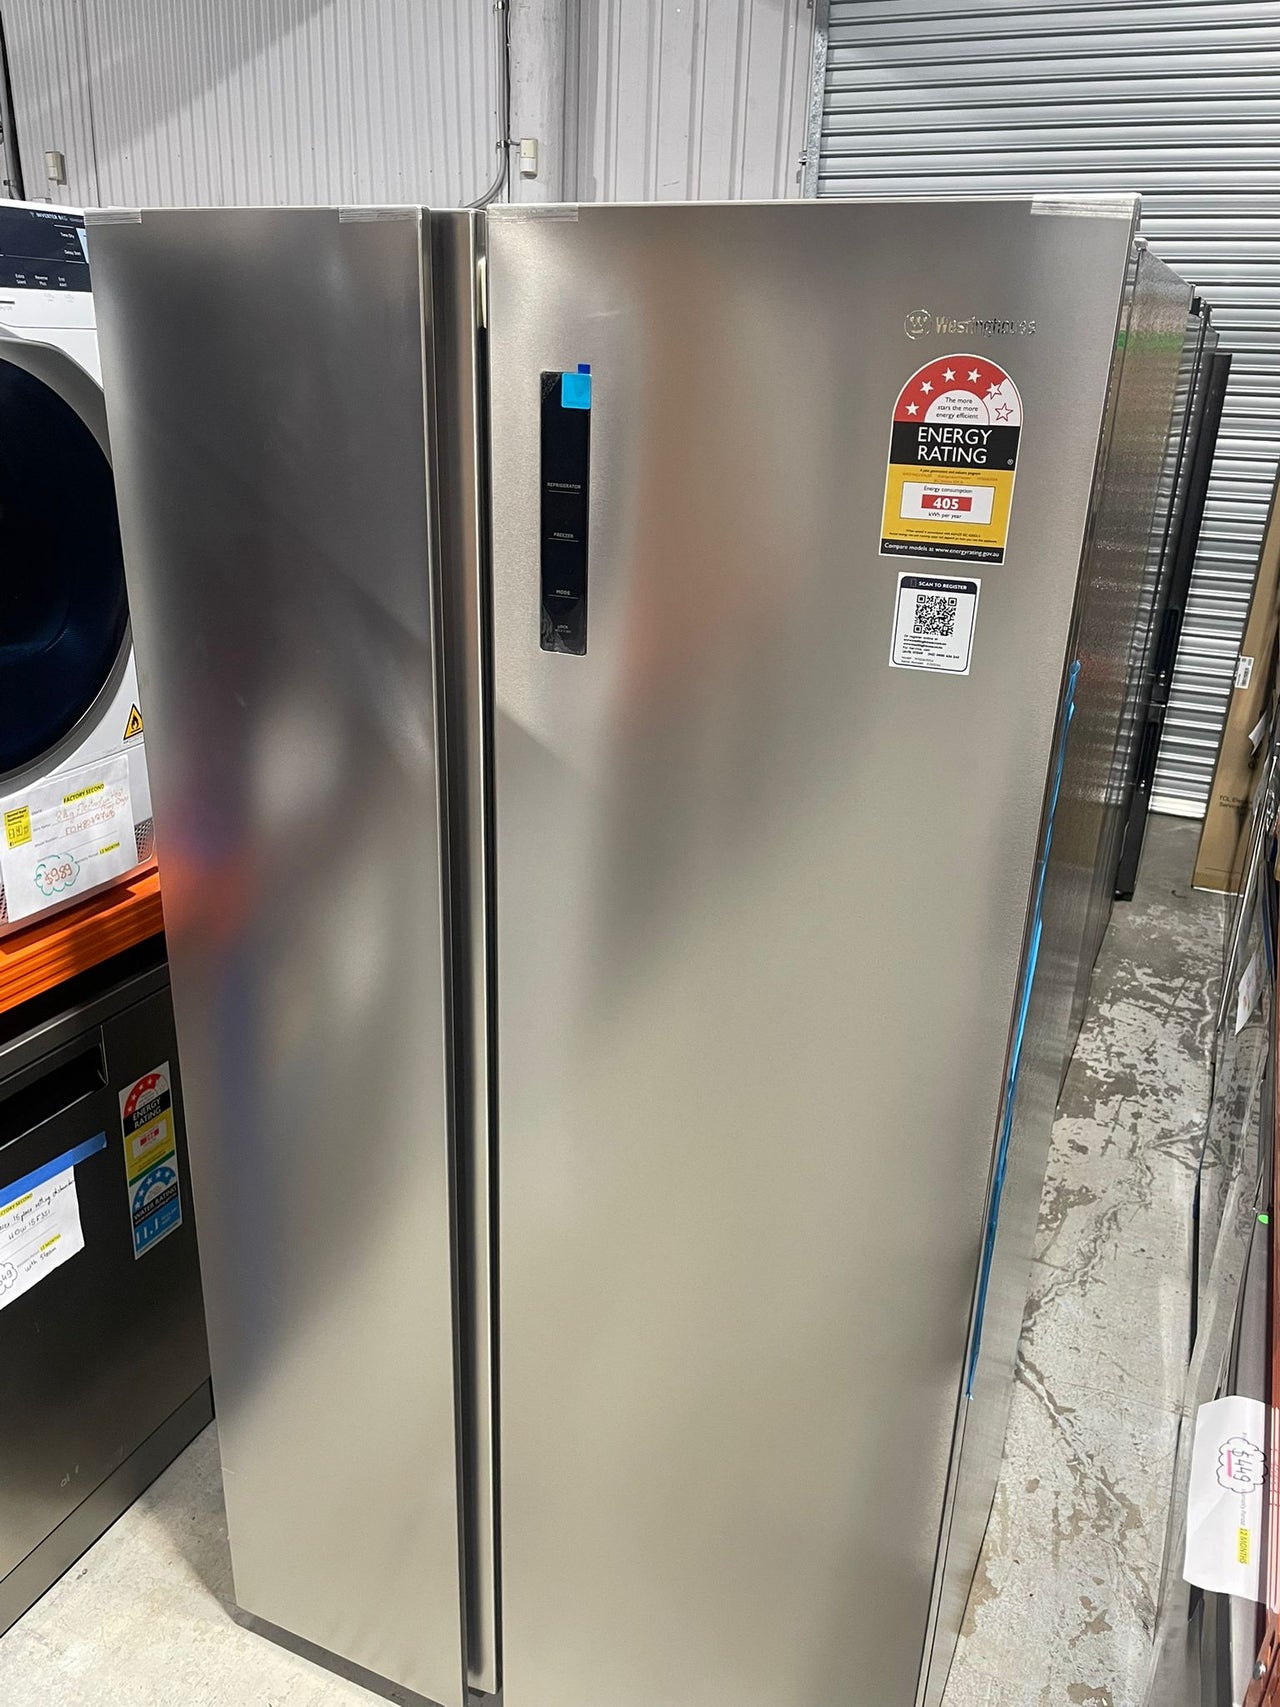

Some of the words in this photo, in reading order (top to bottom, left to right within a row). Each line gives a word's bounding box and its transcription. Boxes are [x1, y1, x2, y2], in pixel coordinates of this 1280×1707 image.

[937, 404, 951, 412] stars
[945, 396, 956, 404] The
[936, 412, 955, 420] energy
[956, 412, 979, 420] efficient
[917, 426, 993, 445] ENERGY
[917, 445, 988, 464] RATING
[923, 485, 940, 493] Energy
[933, 497, 959, 510] 405
[884, 542, 908, 551] Compare
[909, 544, 928, 552] models
[935, 547, 1000, 558] www.energyrating.gov.au
[63, 790, 85, 804] FACTORY
[85, 783, 105, 796] SECOND
[44, 863, 73, 886] $989
[133, 1097, 161, 1122] ENERGY
[134, 1106, 162, 1129] RATING
[134, 1202, 155, 1220] WATER
[155, 1185, 177, 1204] RATING
[1231, 1447, 1254, 1483] $449
[1239, 1535, 1248, 1564] MONTHS
